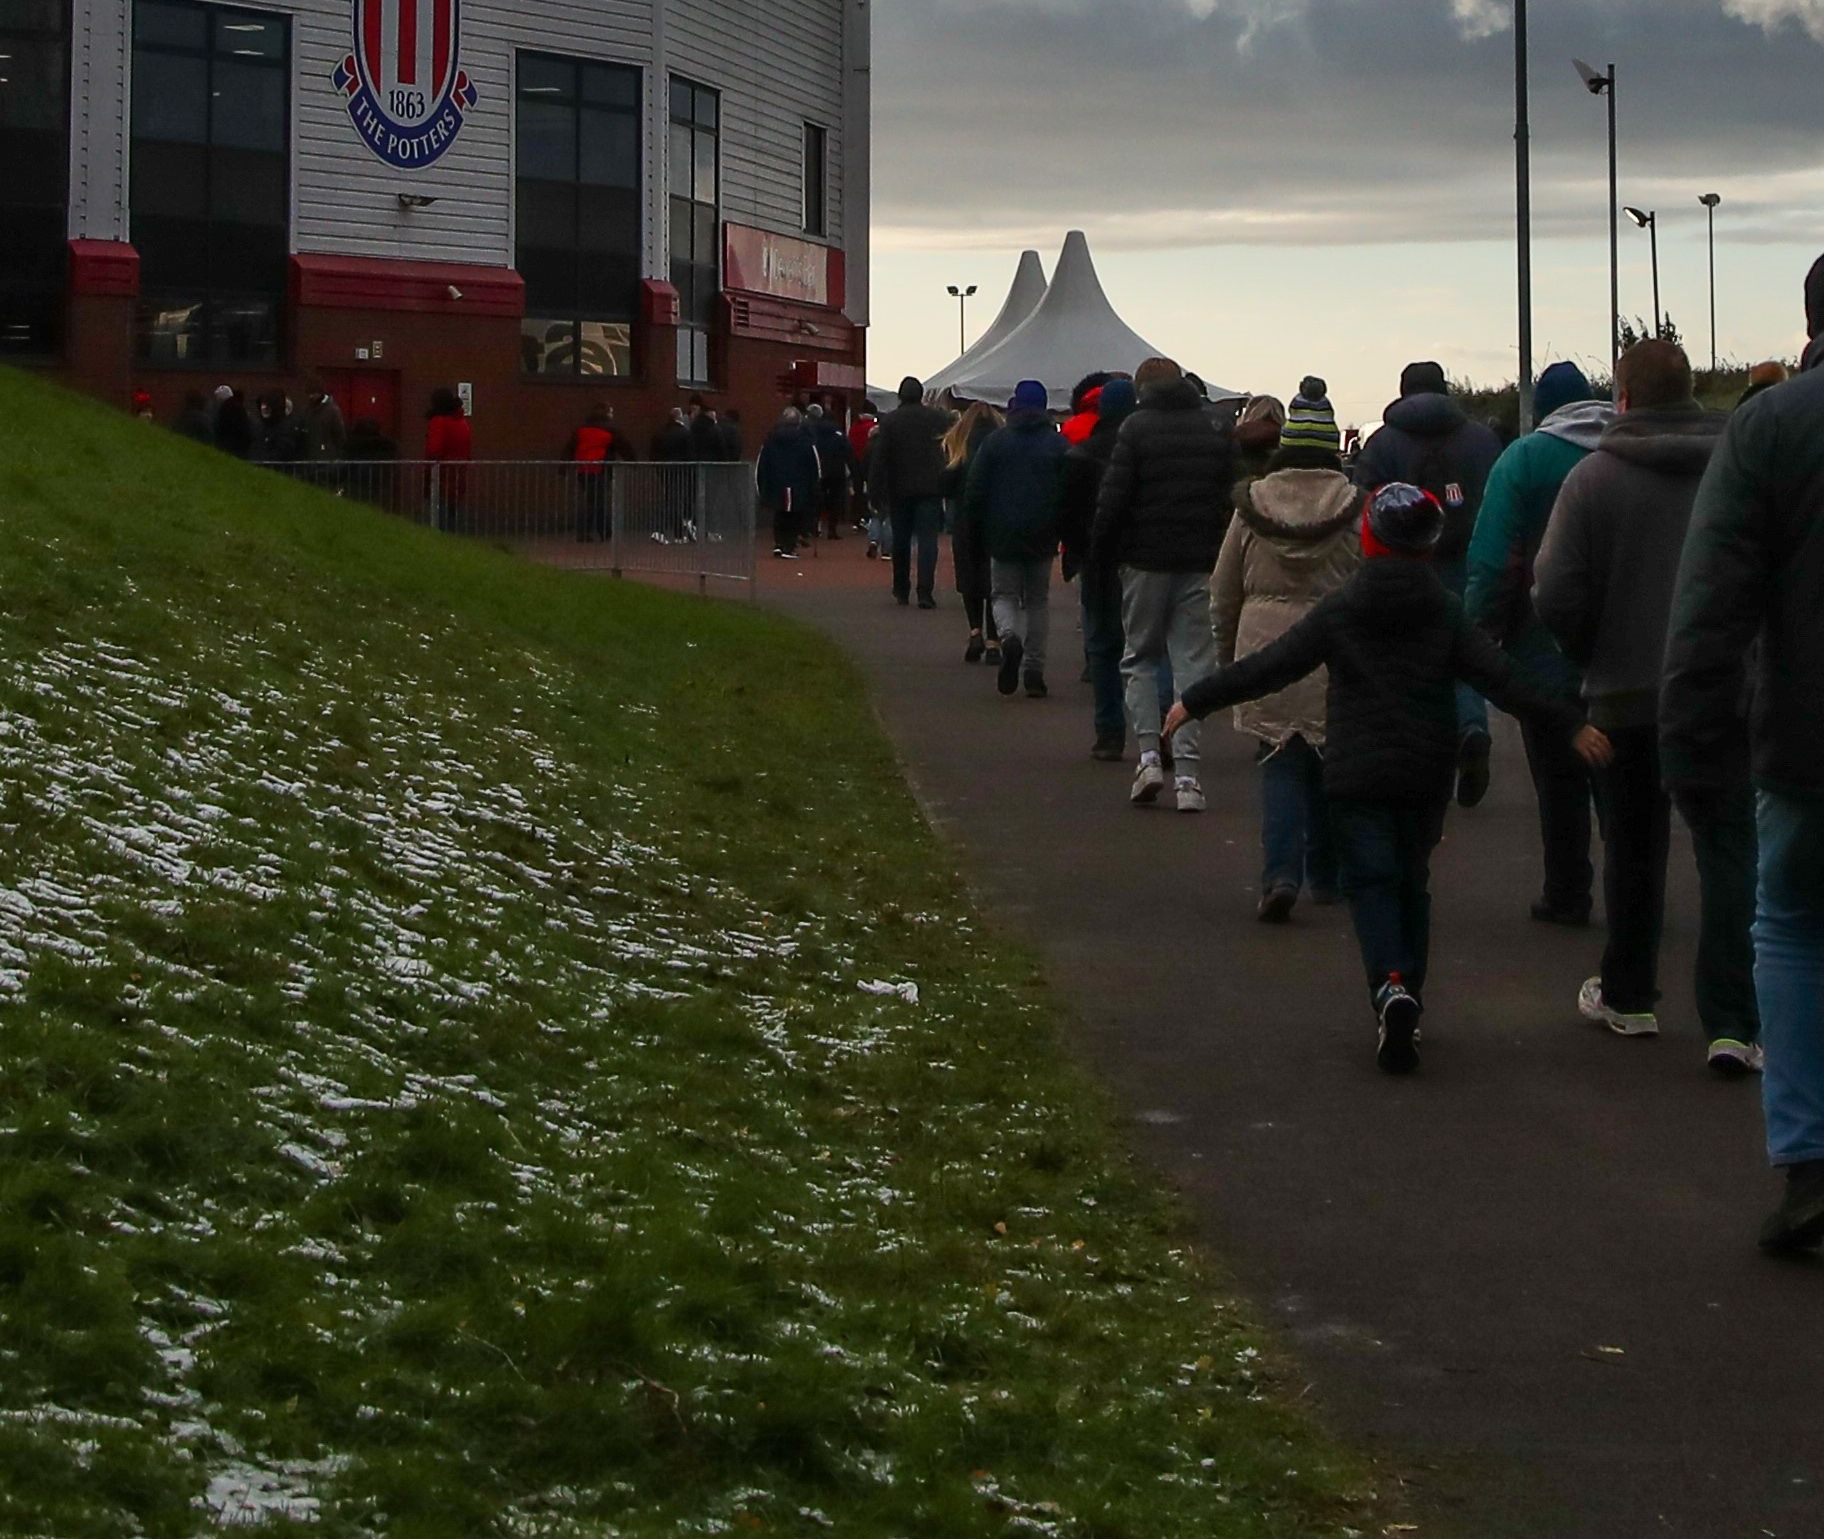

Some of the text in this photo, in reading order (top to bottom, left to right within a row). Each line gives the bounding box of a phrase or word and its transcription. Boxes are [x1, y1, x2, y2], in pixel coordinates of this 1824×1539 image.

[389, 90, 424, 118] 1863
[357, 97, 455, 159] THE POTTERS
